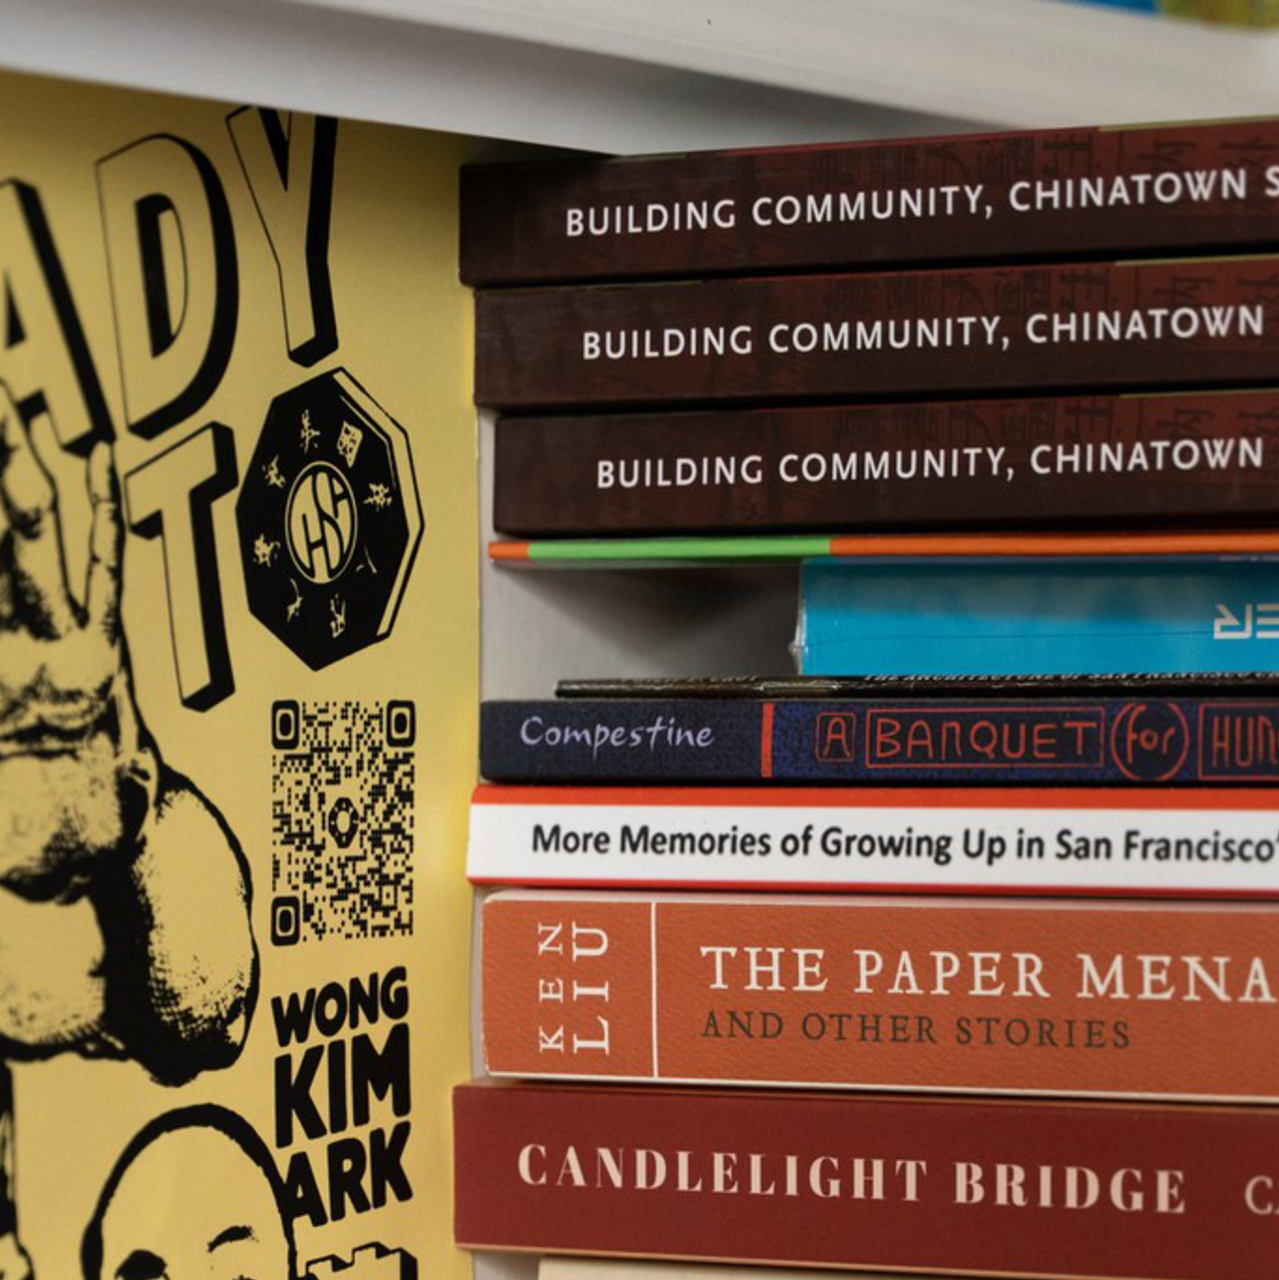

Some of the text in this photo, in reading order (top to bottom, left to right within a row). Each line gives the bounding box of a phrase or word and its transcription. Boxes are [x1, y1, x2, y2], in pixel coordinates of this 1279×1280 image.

[565, 199, 737, 238] BUILDING
[751, 182, 994, 228] COMMUNITY,
[1008, 167, 1248, 212] CHINATOWN
[581, 324, 754, 361] BUILDING
[767, 314, 1011, 354] COMMUNITY,
[1024, 303, 1265, 344] CHINATOWN
[596, 454, 764, 490] BUILDING
[777, 445, 1016, 483] COMMUNITY,
[1029, 435, 1264, 475] CHINATOWN
[518, 714, 716, 762] Compestine
[822, 716, 851, 758] A
[875, 717, 1098, 758] BANQUET
[531, 823, 611, 856] More
[619, 823, 773, 858] Memories
[779, 823, 814, 857] of
[821, 826, 953, 866] Growing
[962, 828, 1008, 868] Up
[1017, 829, 1045, 859] in
[1055, 829, 1113, 861] San
[537, 921, 565, 1054] KEN
[571, 921, 610, 1055] LIU
[700, 945, 829, 993] THE
[853, 949, 1052, 999] PAPER
[272, 966, 410, 1049] WONG
[701, 1009, 1131, 1050] AND OTHER STORIES
[274, 1022, 411, 1149] KIM
[285, 1122, 413, 1230] ARK
[517, 1142, 929, 1202] CANDLELIGHT
[953, 1160, 1186, 1214] BRIDGE
